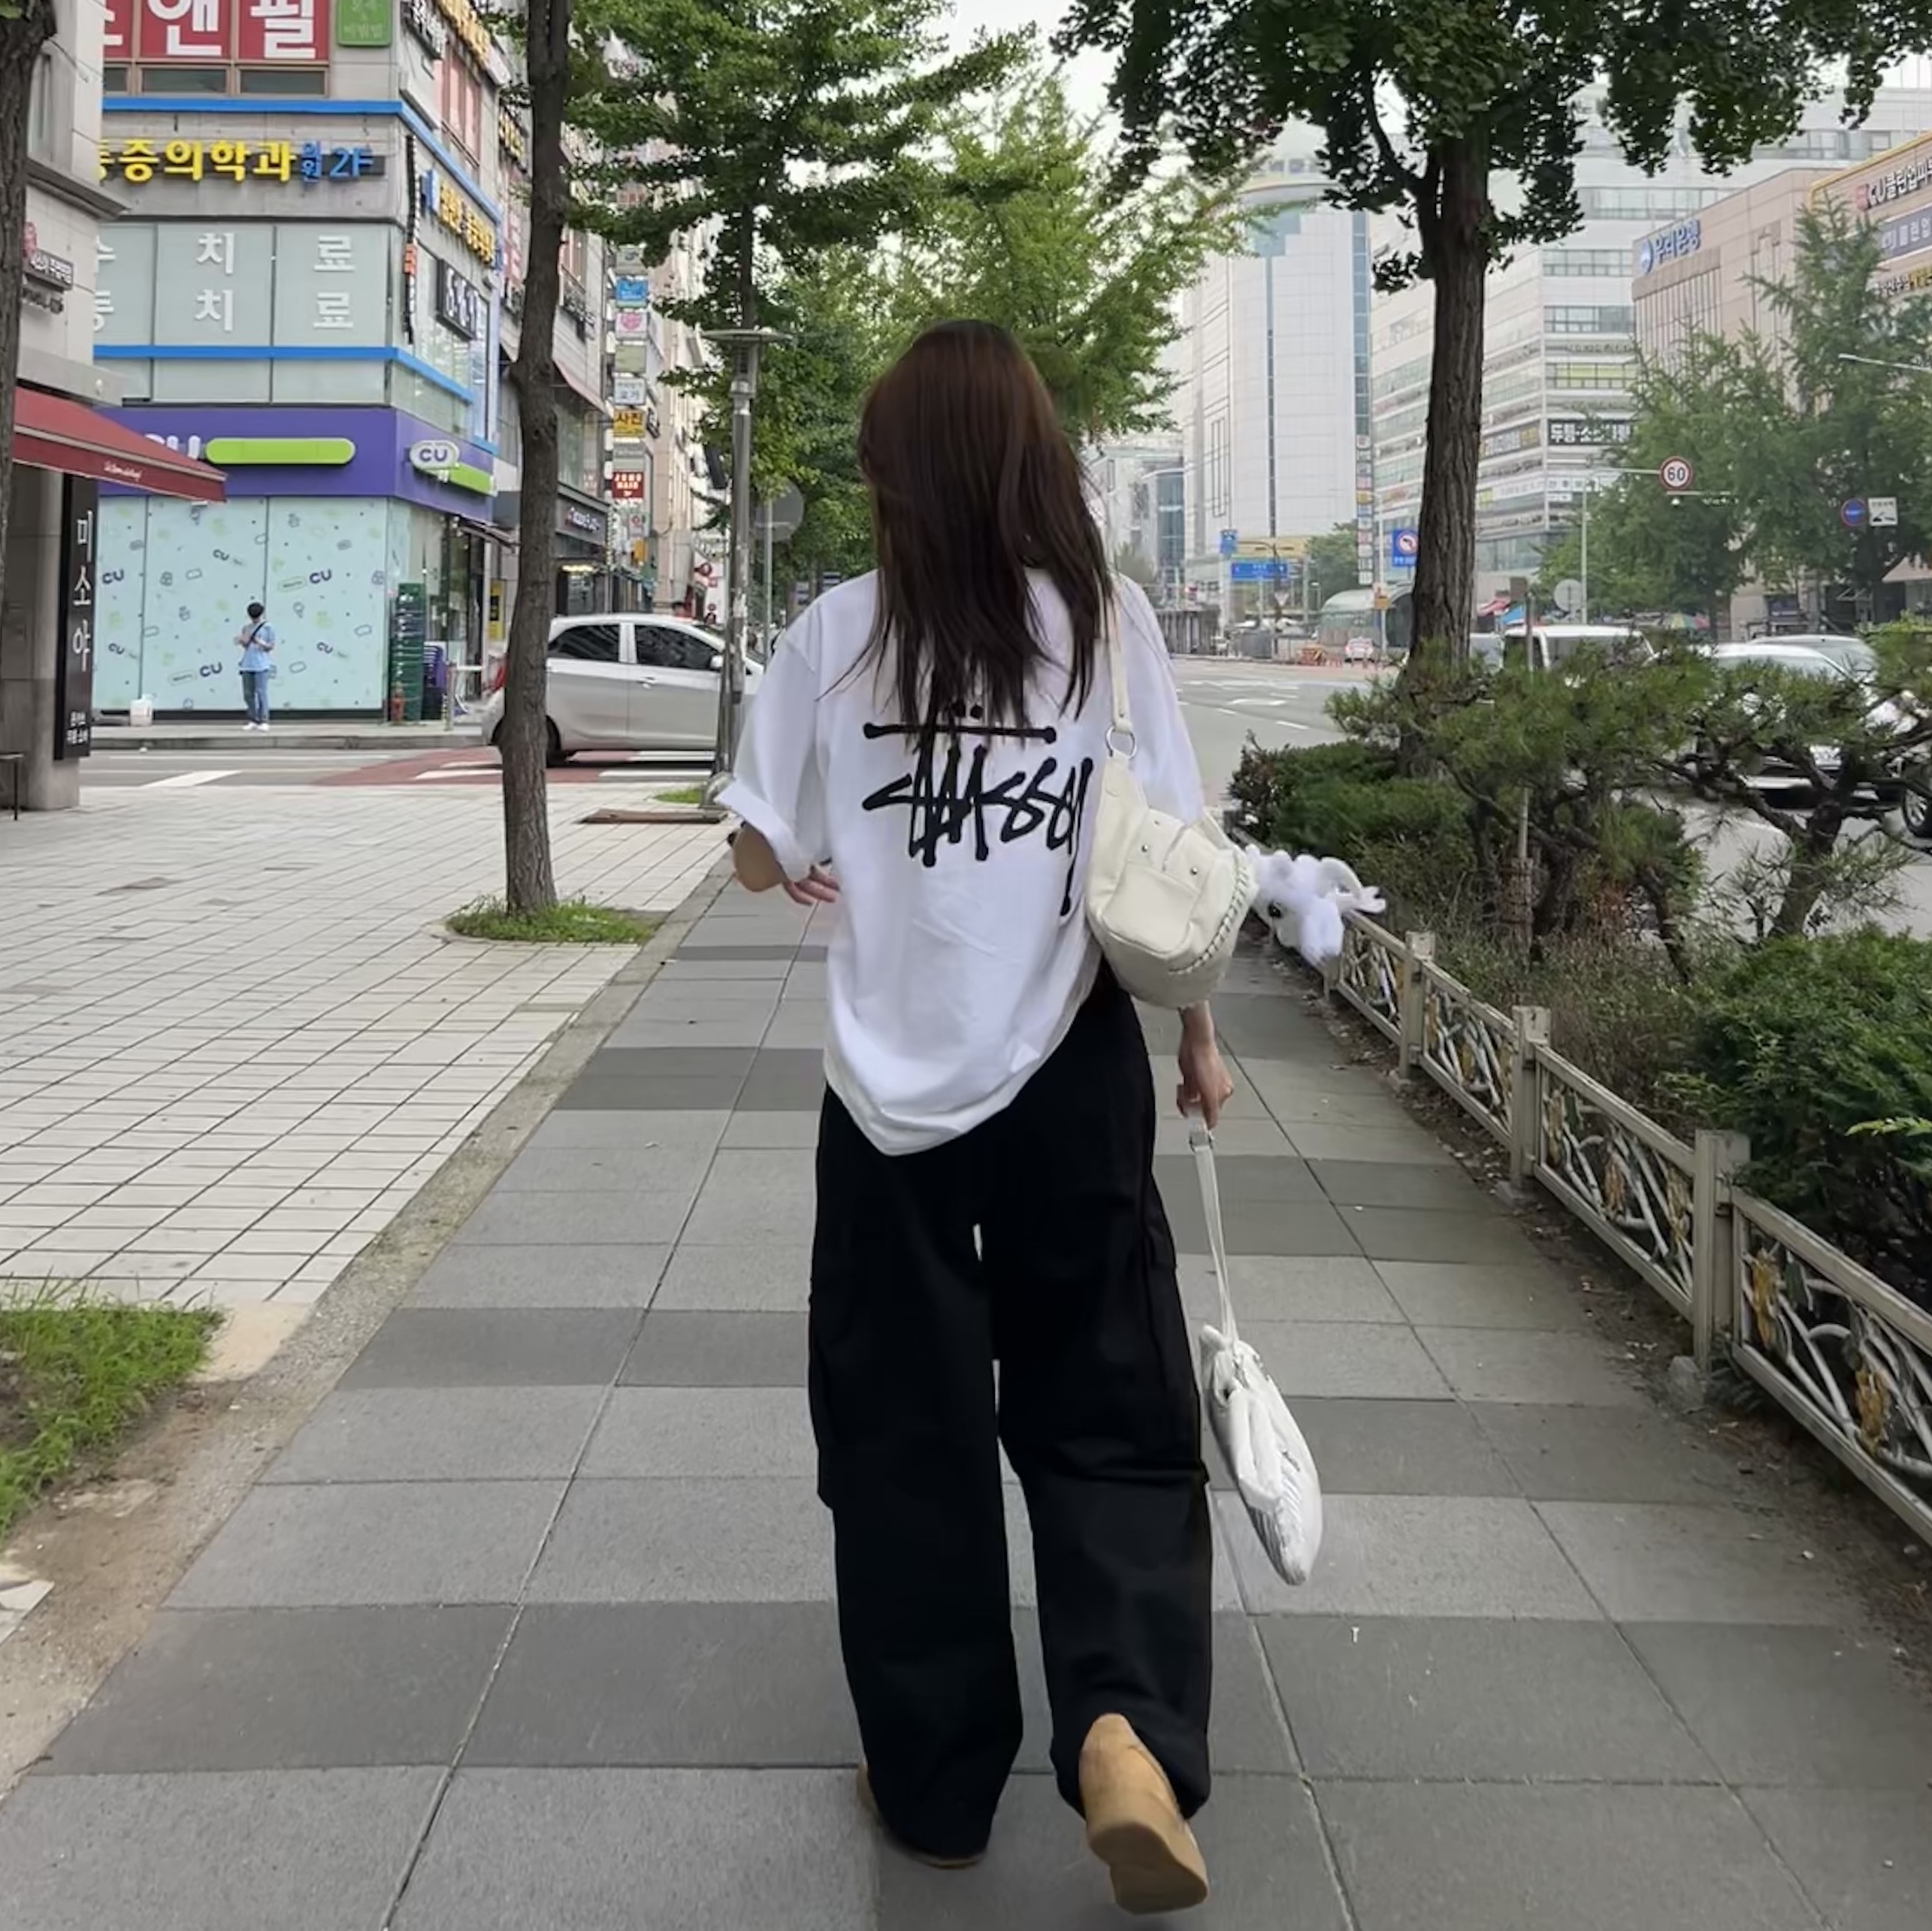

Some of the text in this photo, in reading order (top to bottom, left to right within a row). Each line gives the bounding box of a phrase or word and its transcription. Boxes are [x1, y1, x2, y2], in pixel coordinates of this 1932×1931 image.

[329, 147, 373, 178] 2F
[1654, 219, 1701, 264] 우리은행
[419, 448, 449, 463] CU
[1667, 467, 1686, 482] 60
[213, 548, 230, 561] CU
[101, 569, 125, 585] CU
[309, 569, 333, 584] CU
[72, 510, 94, 672] 미소야
[107, 642, 125, 655] CU
[316, 642, 333, 654] CU
[199, 661, 222, 677] CU
